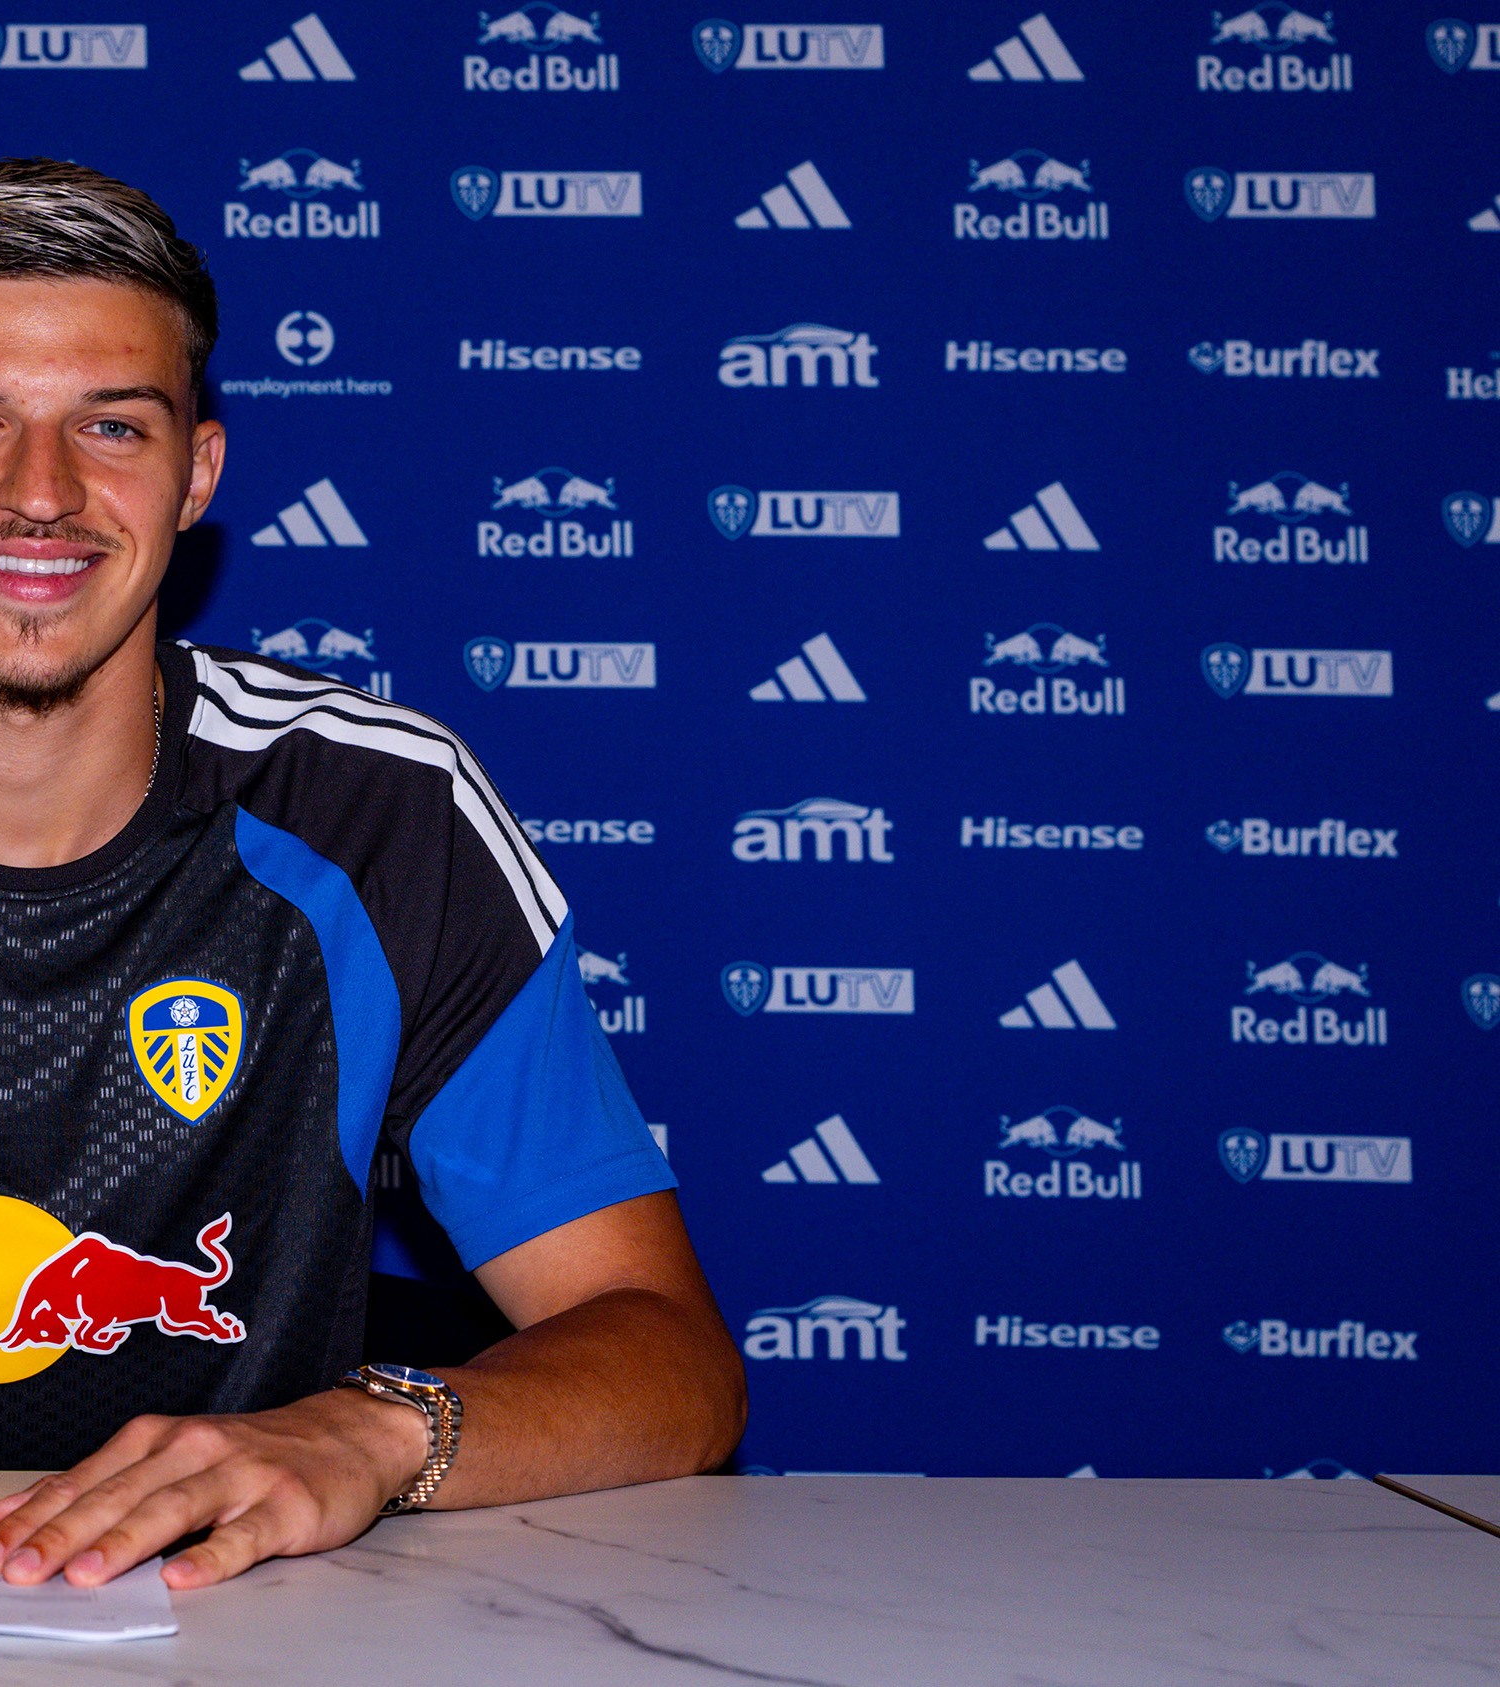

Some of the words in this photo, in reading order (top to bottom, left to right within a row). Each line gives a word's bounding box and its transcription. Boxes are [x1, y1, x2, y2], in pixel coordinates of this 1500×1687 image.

[464, 55, 540, 91] Red
[545, 54, 619, 91] Bull
[1197, 54, 1273, 91] Red
[1279, 54, 1352, 91] Bull
[224, 201, 300, 238] Red
[306, 201, 380, 238] Bull
[954, 202, 1030, 239] Red
[1035, 202, 1109, 240] Bull
[459, 339, 641, 370] Hisense
[718, 331, 879, 388] amt
[945, 341, 1127, 372] Hisense
[1223, 339, 1379, 377] Burflex
[346, 376, 392, 394] hero
[478, 520, 554, 557] Red
[560, 520, 633, 558] Bull
[1214, 526, 1290, 563] Red
[1295, 526, 1368, 563] Bull
[970, 677, 1046, 714] Red
[1051, 678, 1125, 715] Bull
[513, 812, 656, 844] sense
[732, 806, 894, 862] amt
[961, 817, 1144, 849] Hisense
[1241, 818, 1397, 857] Burflex
[590, 995, 646, 1034] ull
[1231, 1006, 1307, 1043] Red
[1314, 1008, 1387, 1045] Bull
[985, 1160, 1061, 1197] Red
[1067, 1162, 1141, 1199] Bull
[744, 1304, 907, 1361] amt
[976, 1316, 1160, 1349] Hisense
[1259, 1320, 1417, 1360] Burflex
